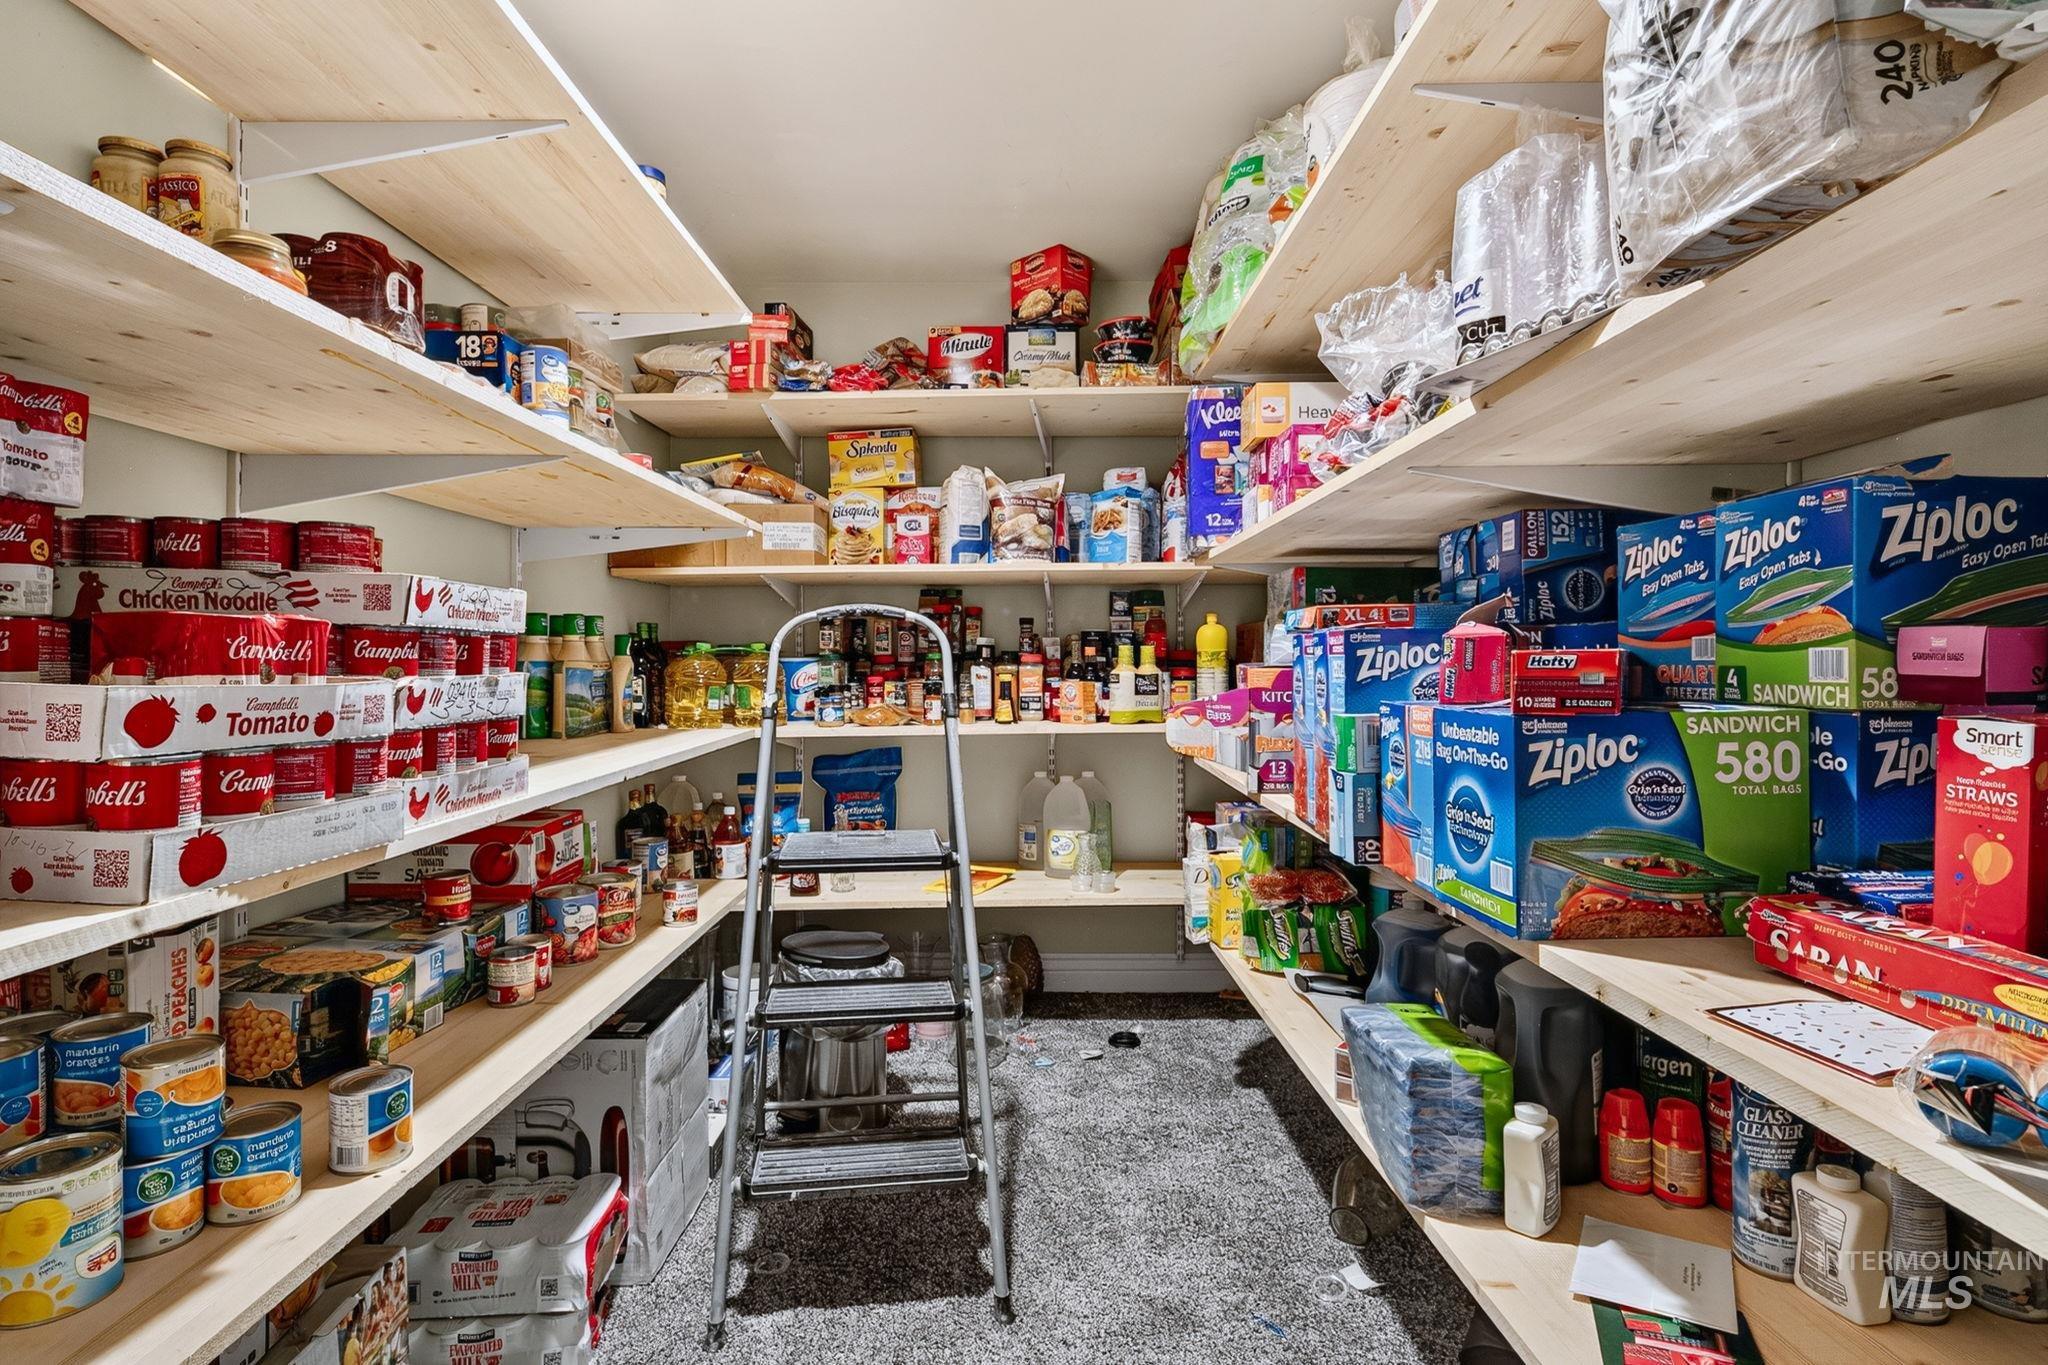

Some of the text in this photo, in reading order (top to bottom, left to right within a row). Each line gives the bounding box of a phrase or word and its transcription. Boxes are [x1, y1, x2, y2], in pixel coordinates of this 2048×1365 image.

[1873, 40, 1914, 105] 240
[1909, 43, 1930, 92] NAPKINS
[455, 335, 481, 358] 18
[941, 335, 993, 356] Minute
[846, 440, 898, 458] Splenda
[1205, 513, 1221, 527] 12
[1550, 510, 1568, 546] 152
[1880, 496, 2018, 563] Ziploc
[1724, 515, 1802, 572] Ziploc
[1961, 551, 1990, 569] Easy
[1993, 541, 2027, 559] Open
[1625, 536, 1683, 582] Ziploc
[1739, 550, 1812, 591] Easy Open Tabs
[1642, 560, 1705, 597] Easy Open Tabs
[118, 589, 279, 612] Chicken Noodle
[1539, 581, 1556, 621] Ziploc
[1344, 608, 1366, 622] XL
[1356, 641, 1442, 682] Ziploc
[1529, 655, 1575, 668] Hefty
[1657, 665, 1717, 684] QUART
[1726, 669, 1738, 686] 4
[1516, 697, 1533, 708] 10
[1753, 685, 1850, 707] SANDWICH
[226, 709, 310, 737] Tomato
[1441, 722, 1500, 746] Unbeatable
[1686, 715, 1801, 736] SANDWICH
[1966, 727, 2024, 748] Smart
[1528, 733, 1640, 788] Ziploc
[1714, 740, 1801, 785] 580
[1980, 744, 2023, 759] sense
[1269, 761, 1287, 774] 13
[1732, 785, 1802, 796] TOTAL BAGS
[1946, 784, 2019, 808] STRAWS
[1769, 929, 1884, 984] SARAN
[171, 947, 188, 1019] PEACHES
[65, 1042, 120, 1058] mandarin
[65, 1055, 111, 1069] oranges
[1743, 1106, 1793, 1125] GLASS
[1735, 1120, 1804, 1140] CLEANER
[452, 1273, 482, 1292] MILK
